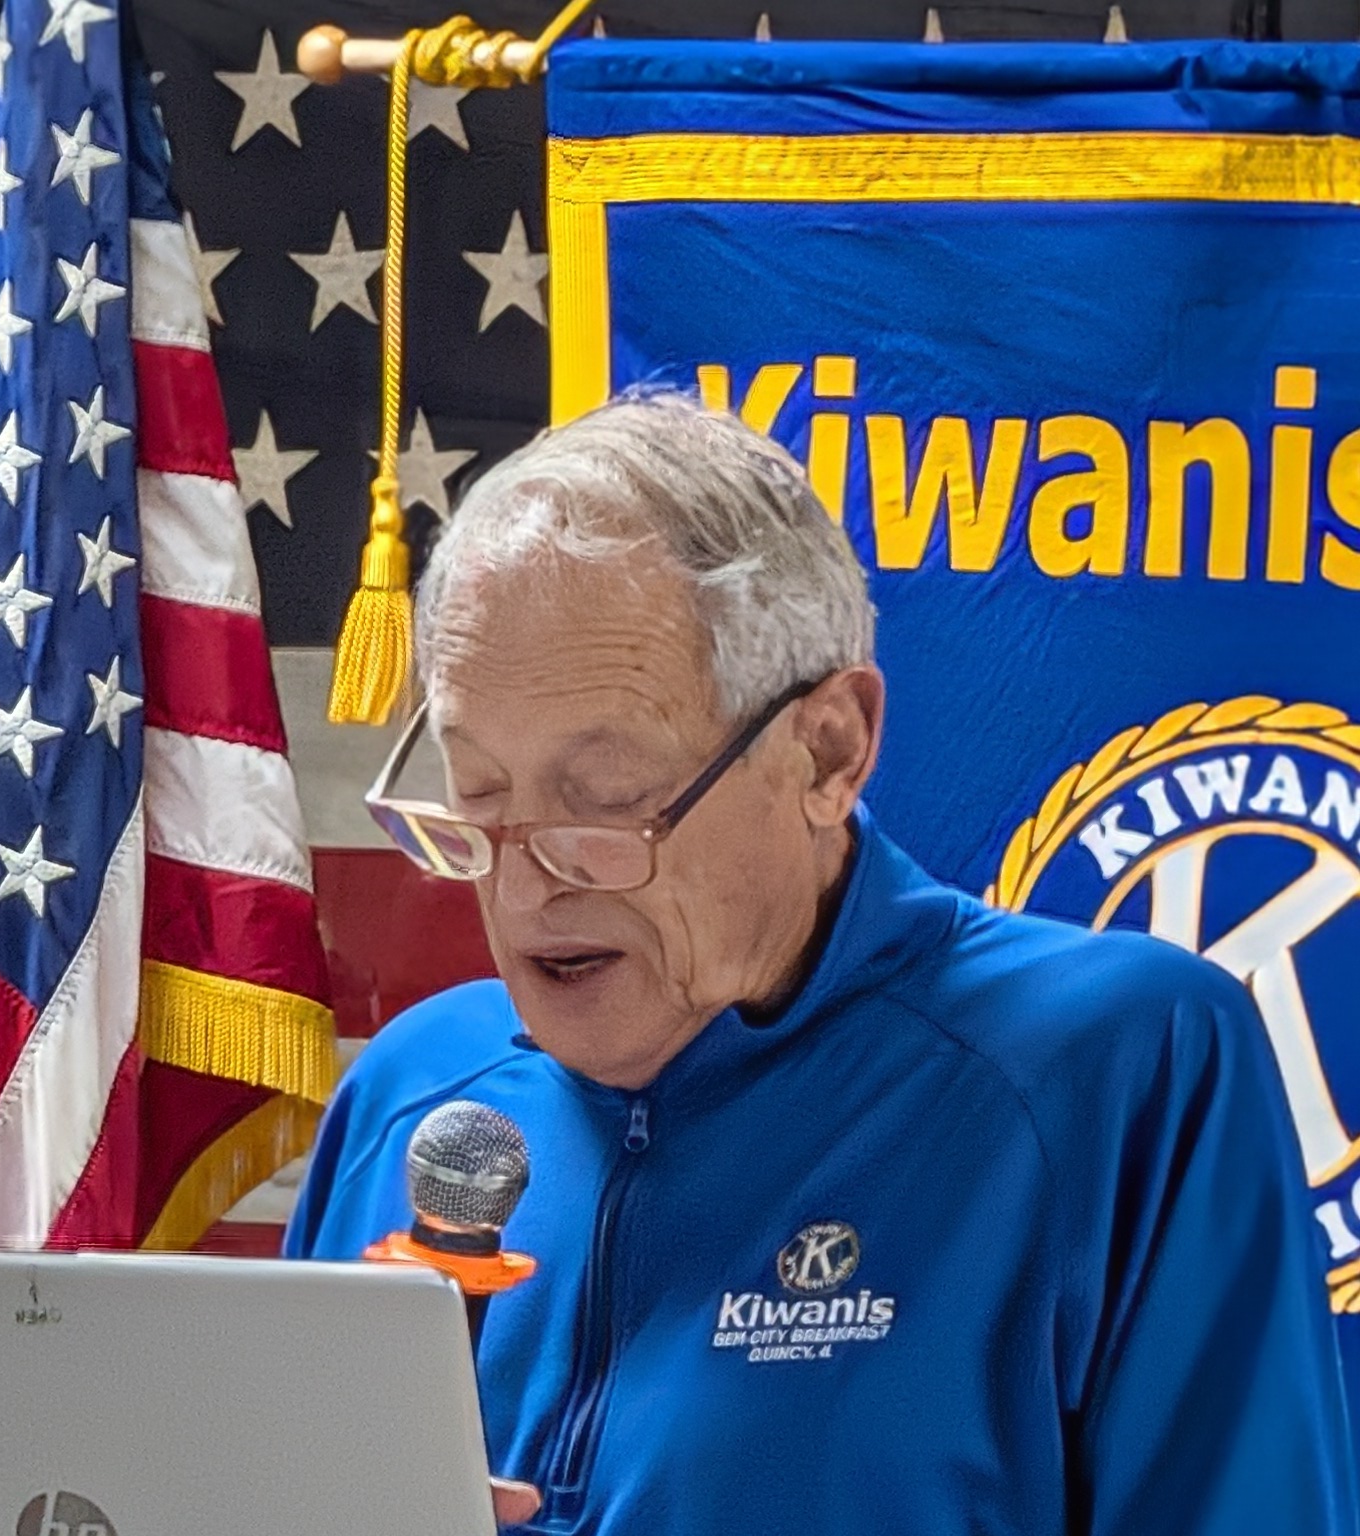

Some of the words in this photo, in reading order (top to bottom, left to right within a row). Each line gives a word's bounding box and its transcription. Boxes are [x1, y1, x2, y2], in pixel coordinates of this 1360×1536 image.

[717, 1289, 895, 1329] Kiwanis
[713, 1330, 748, 1347] GEM
[750, 1329, 788, 1344] CITY
[790, 1324, 891, 1344] BREAKFAST
[748, 1344, 815, 1363] QUINCY,
